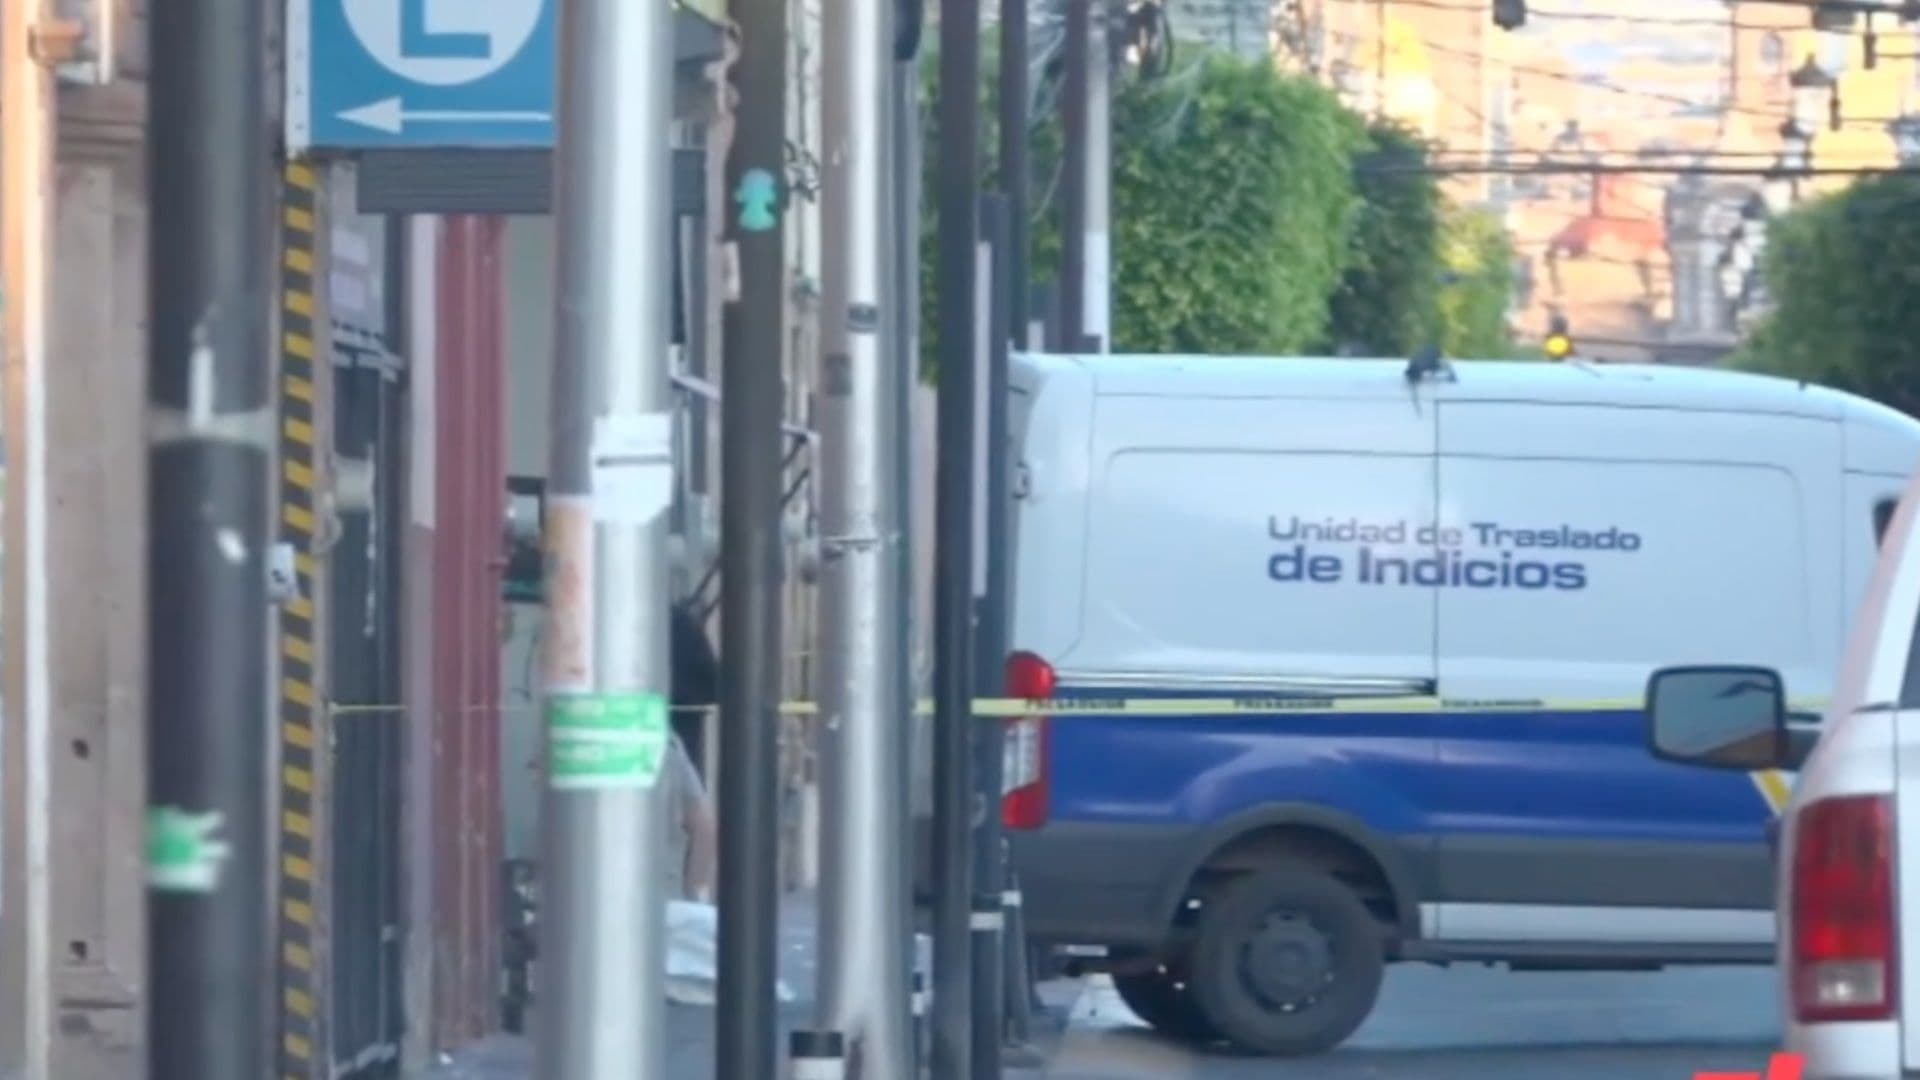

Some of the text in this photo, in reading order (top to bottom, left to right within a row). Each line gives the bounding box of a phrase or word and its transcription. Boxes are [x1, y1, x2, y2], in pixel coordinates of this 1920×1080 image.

[1268, 515, 1642, 552] Unidad de Traslado
[1267, 546, 1588, 590] de Indicios
